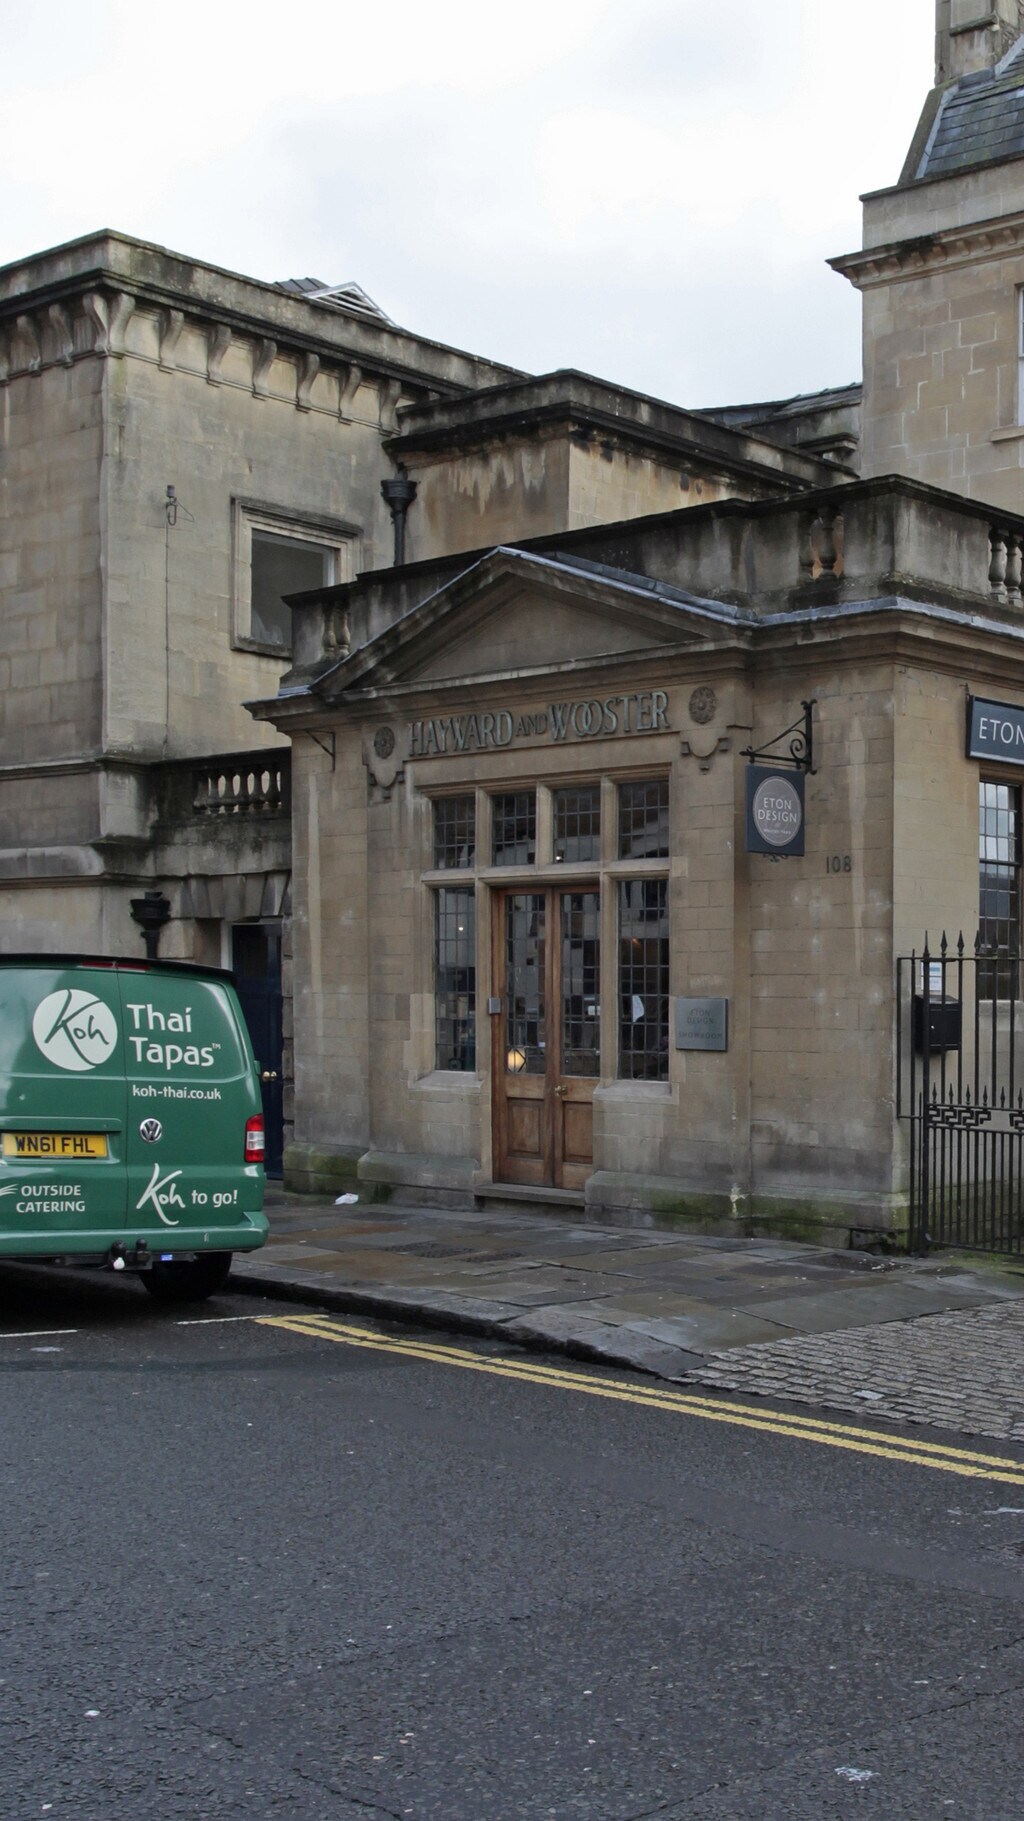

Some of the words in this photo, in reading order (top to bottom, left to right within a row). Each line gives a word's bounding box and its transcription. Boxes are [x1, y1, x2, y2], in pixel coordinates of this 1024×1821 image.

[408, 710, 513, 757] HAYWARD
[516, 713, 547, 737] AND
[548, 690, 670, 741] WOOSTER
[763, 797, 792, 810] ETON
[758, 809, 797, 823] DESIGN
[826, 855, 852, 874] 108
[689, 1008, 711, 1016] ETON
[44, 989, 110, 1067] Koh
[678, 1031, 723, 1040] SHOWROOM
[15, 1136, 56, 1152] WN61
[61, 1137, 95, 1153] FHL
[20, 1184, 82, 1197] OUTSIDE
[136, 1163, 186, 1225] Koh
[191, 1190, 207, 1205] to
[213, 1186, 238, 1208] go!
[16, 1201, 86, 1213] CATERING
